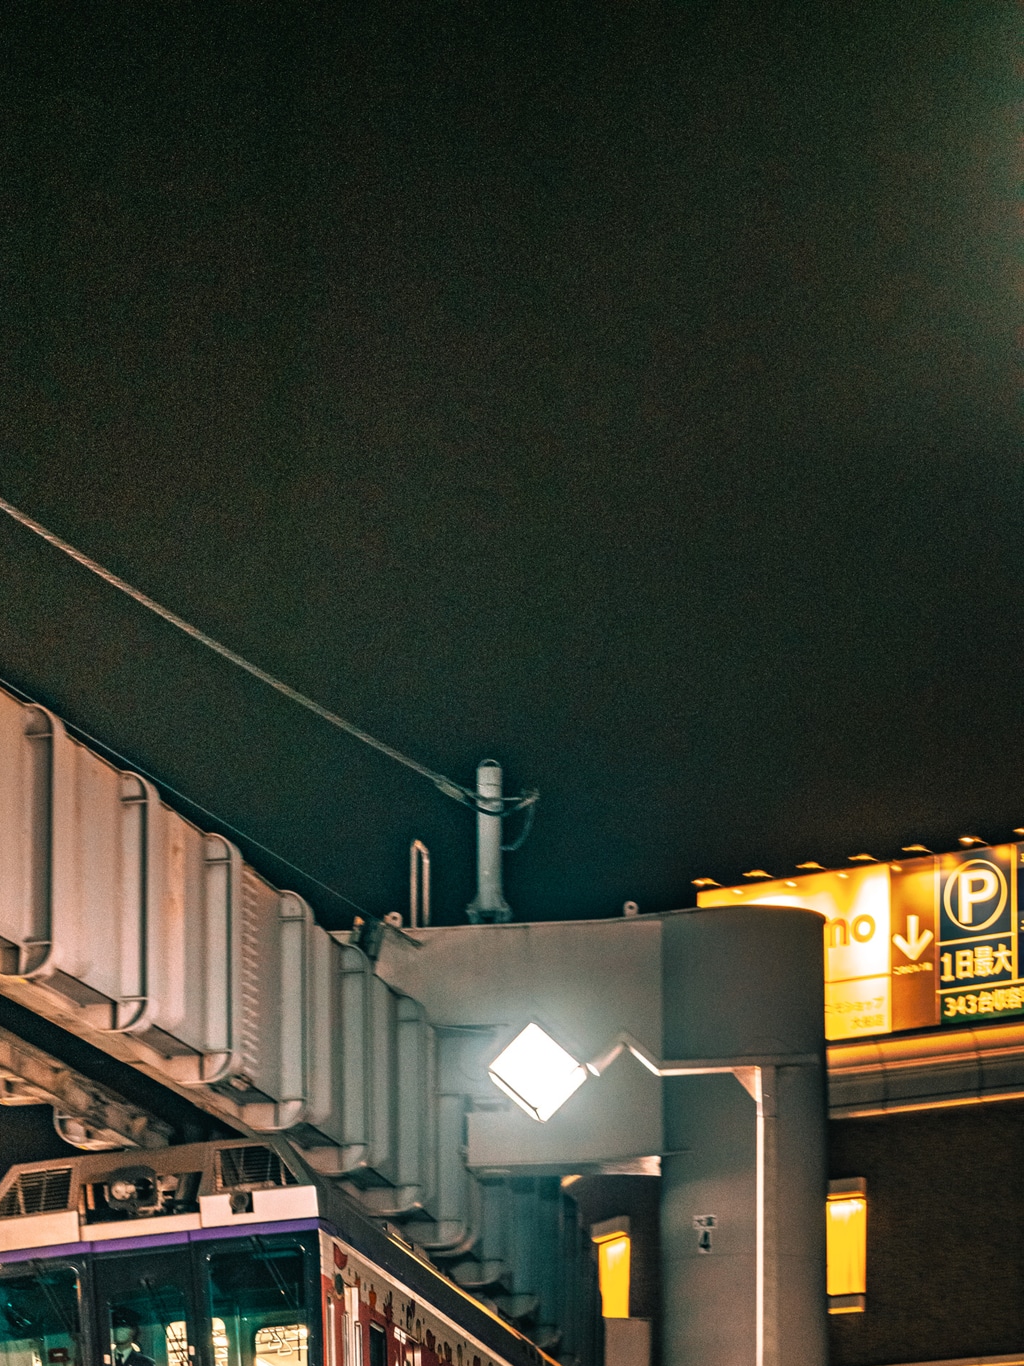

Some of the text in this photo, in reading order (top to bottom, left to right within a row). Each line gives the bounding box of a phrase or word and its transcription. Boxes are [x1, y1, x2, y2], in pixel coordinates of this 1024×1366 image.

[958, 869, 999, 924] P
[941, 943, 1012, 982] 1日最大
[944, 986, 1024, 1017] 343台収容
